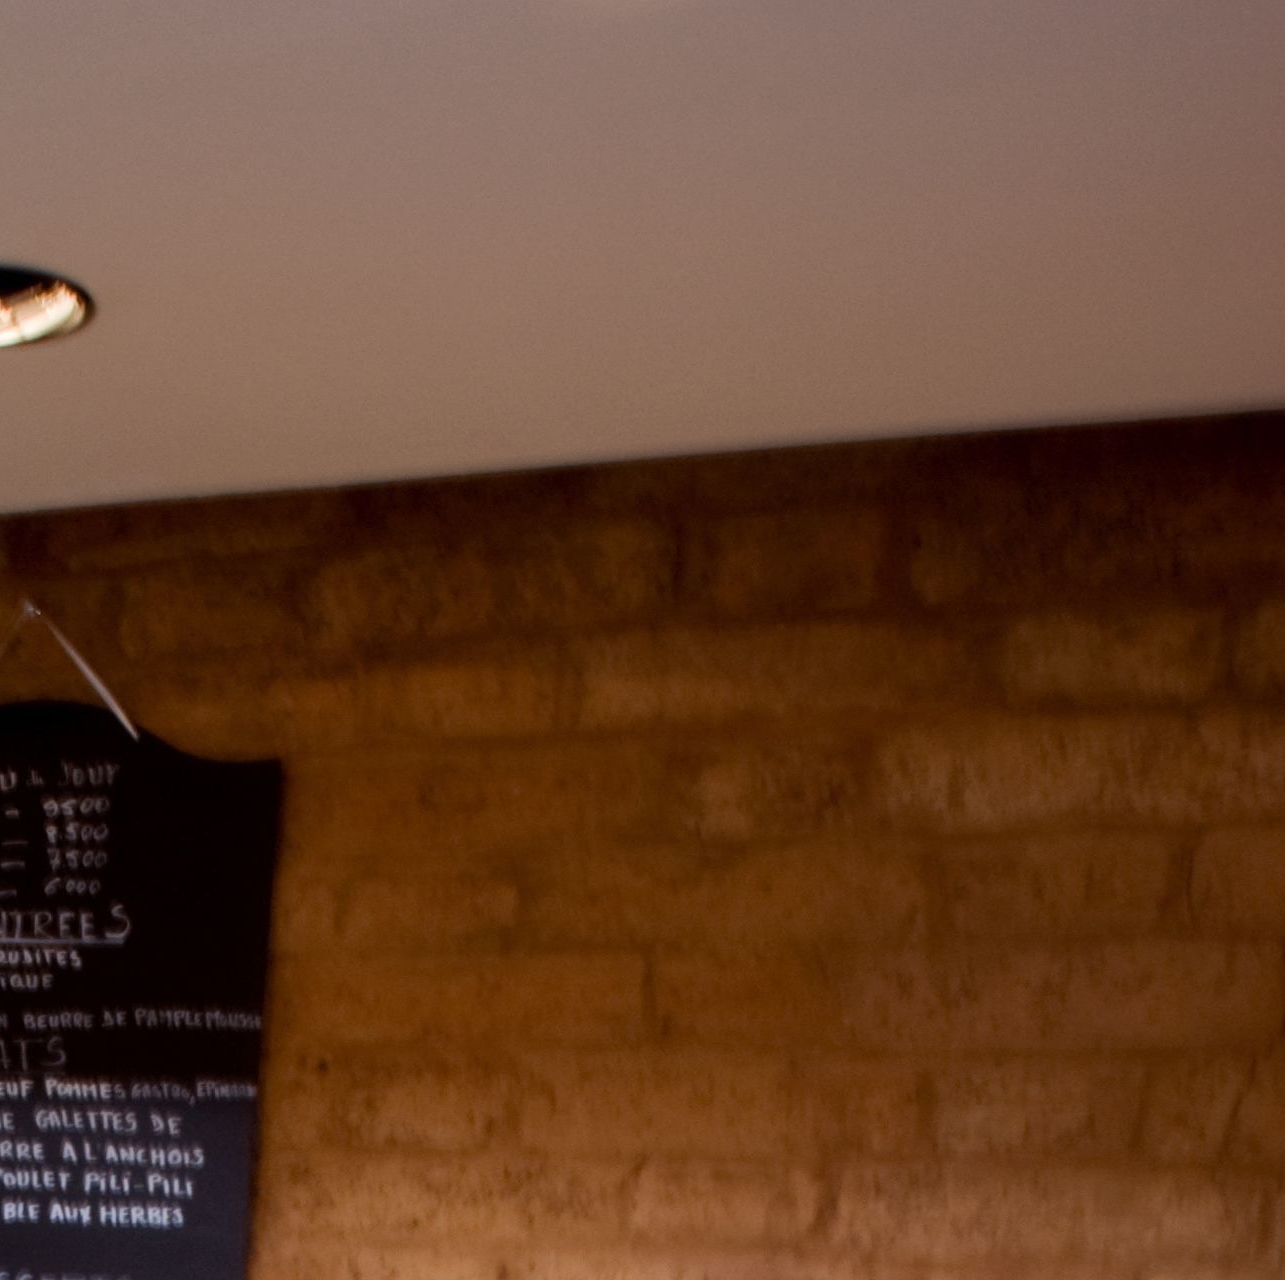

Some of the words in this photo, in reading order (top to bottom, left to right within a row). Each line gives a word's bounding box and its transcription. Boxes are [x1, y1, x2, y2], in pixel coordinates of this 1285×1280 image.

[22, 1009, 94, 1030] BEURRE
[100, 1007, 127, 1029] DE
[44, 1078, 126, 1099] POMMES
[35, 1108, 137, 1134] GALETTES
[150, 1112, 183, 1136] DE
[49, 1201, 91, 1226] AUX
[99, 1203, 184, 1228] HERBES
